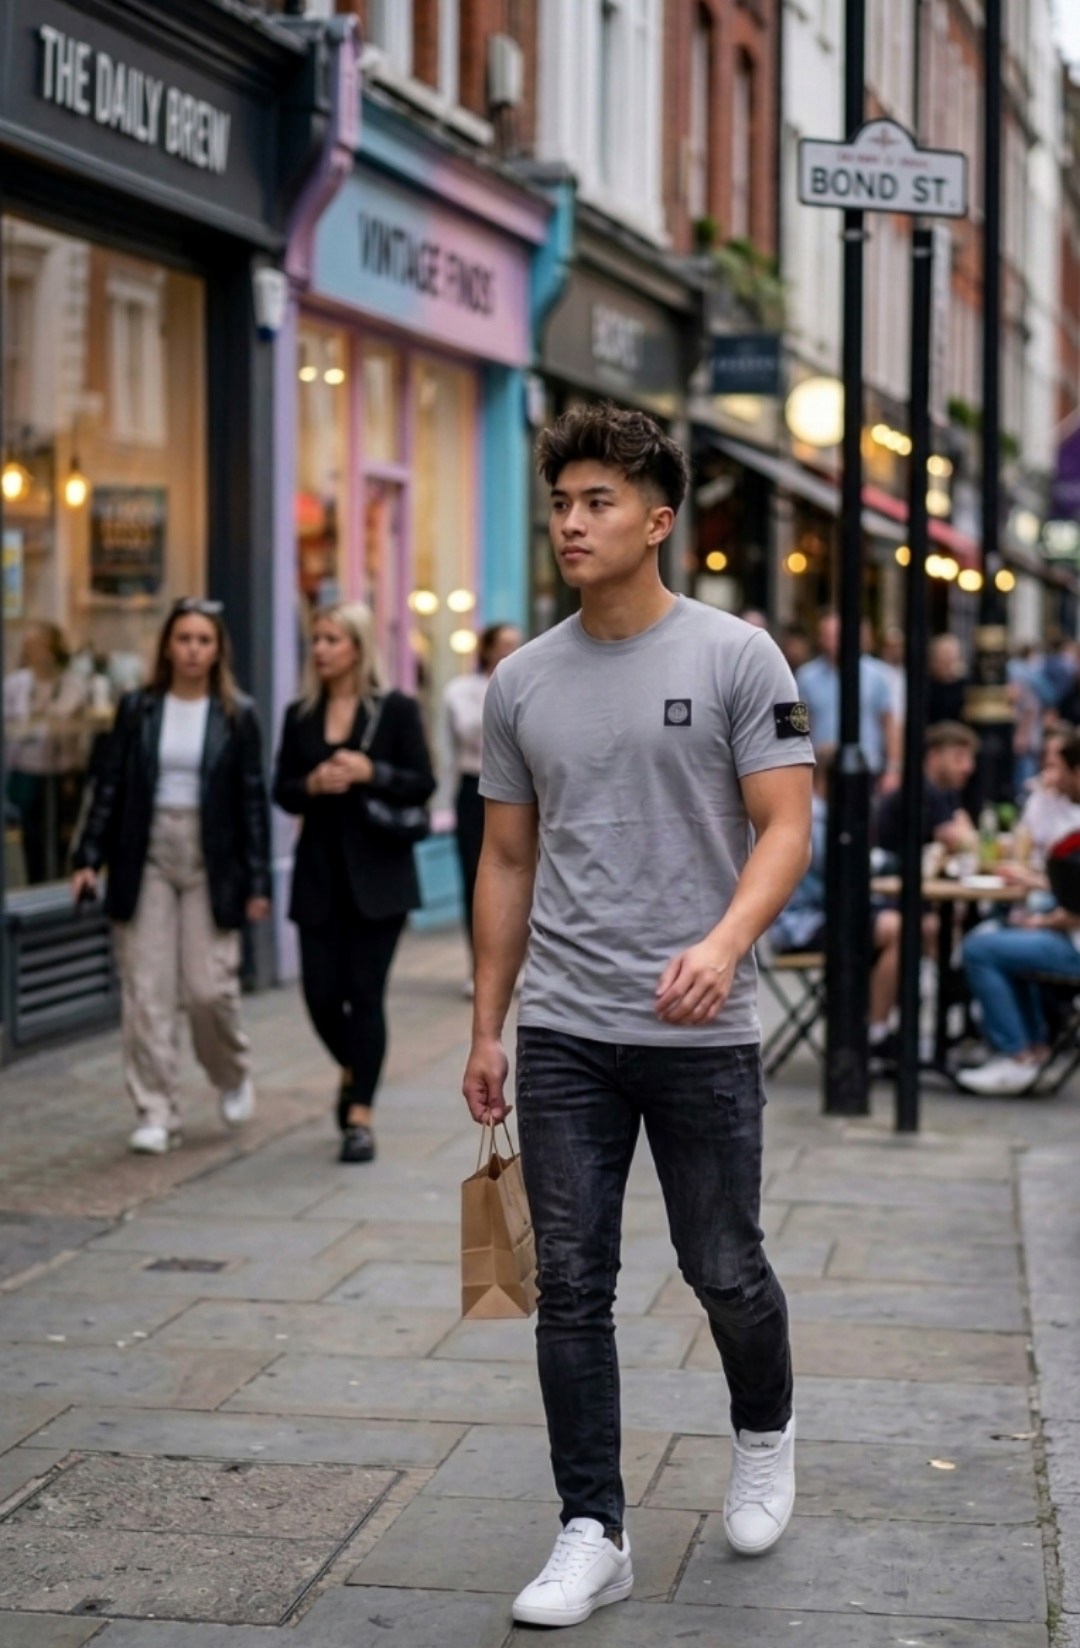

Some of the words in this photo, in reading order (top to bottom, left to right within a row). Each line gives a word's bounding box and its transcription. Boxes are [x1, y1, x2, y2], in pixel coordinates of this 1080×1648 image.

[40, 24, 92, 116] THE
[95, 51, 164, 145] DAILY
[165, 86, 231, 175] BREW
[811, 166, 898, 200] BOND
[358, 211, 440, 298] VINTAGE
